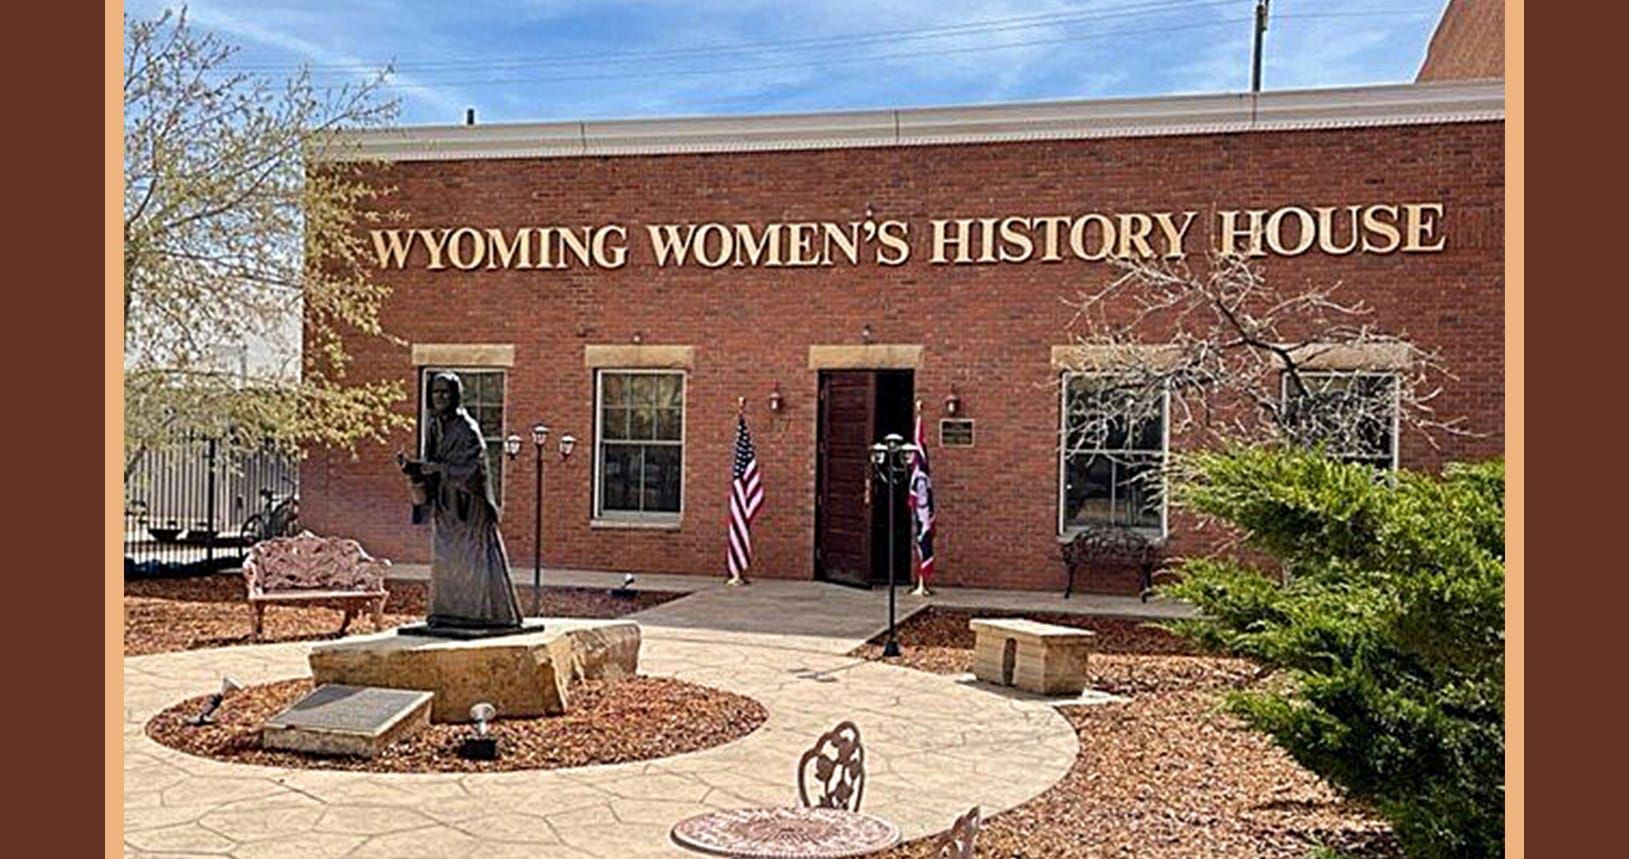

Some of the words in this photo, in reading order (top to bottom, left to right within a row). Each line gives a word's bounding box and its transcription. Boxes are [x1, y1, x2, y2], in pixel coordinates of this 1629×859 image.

[370, 225, 627, 270] WYOMING
[647, 219, 909, 268] WOMEN'S
[930, 211, 1198, 264] HISTORY
[1217, 202, 1446, 256] HOUSE
